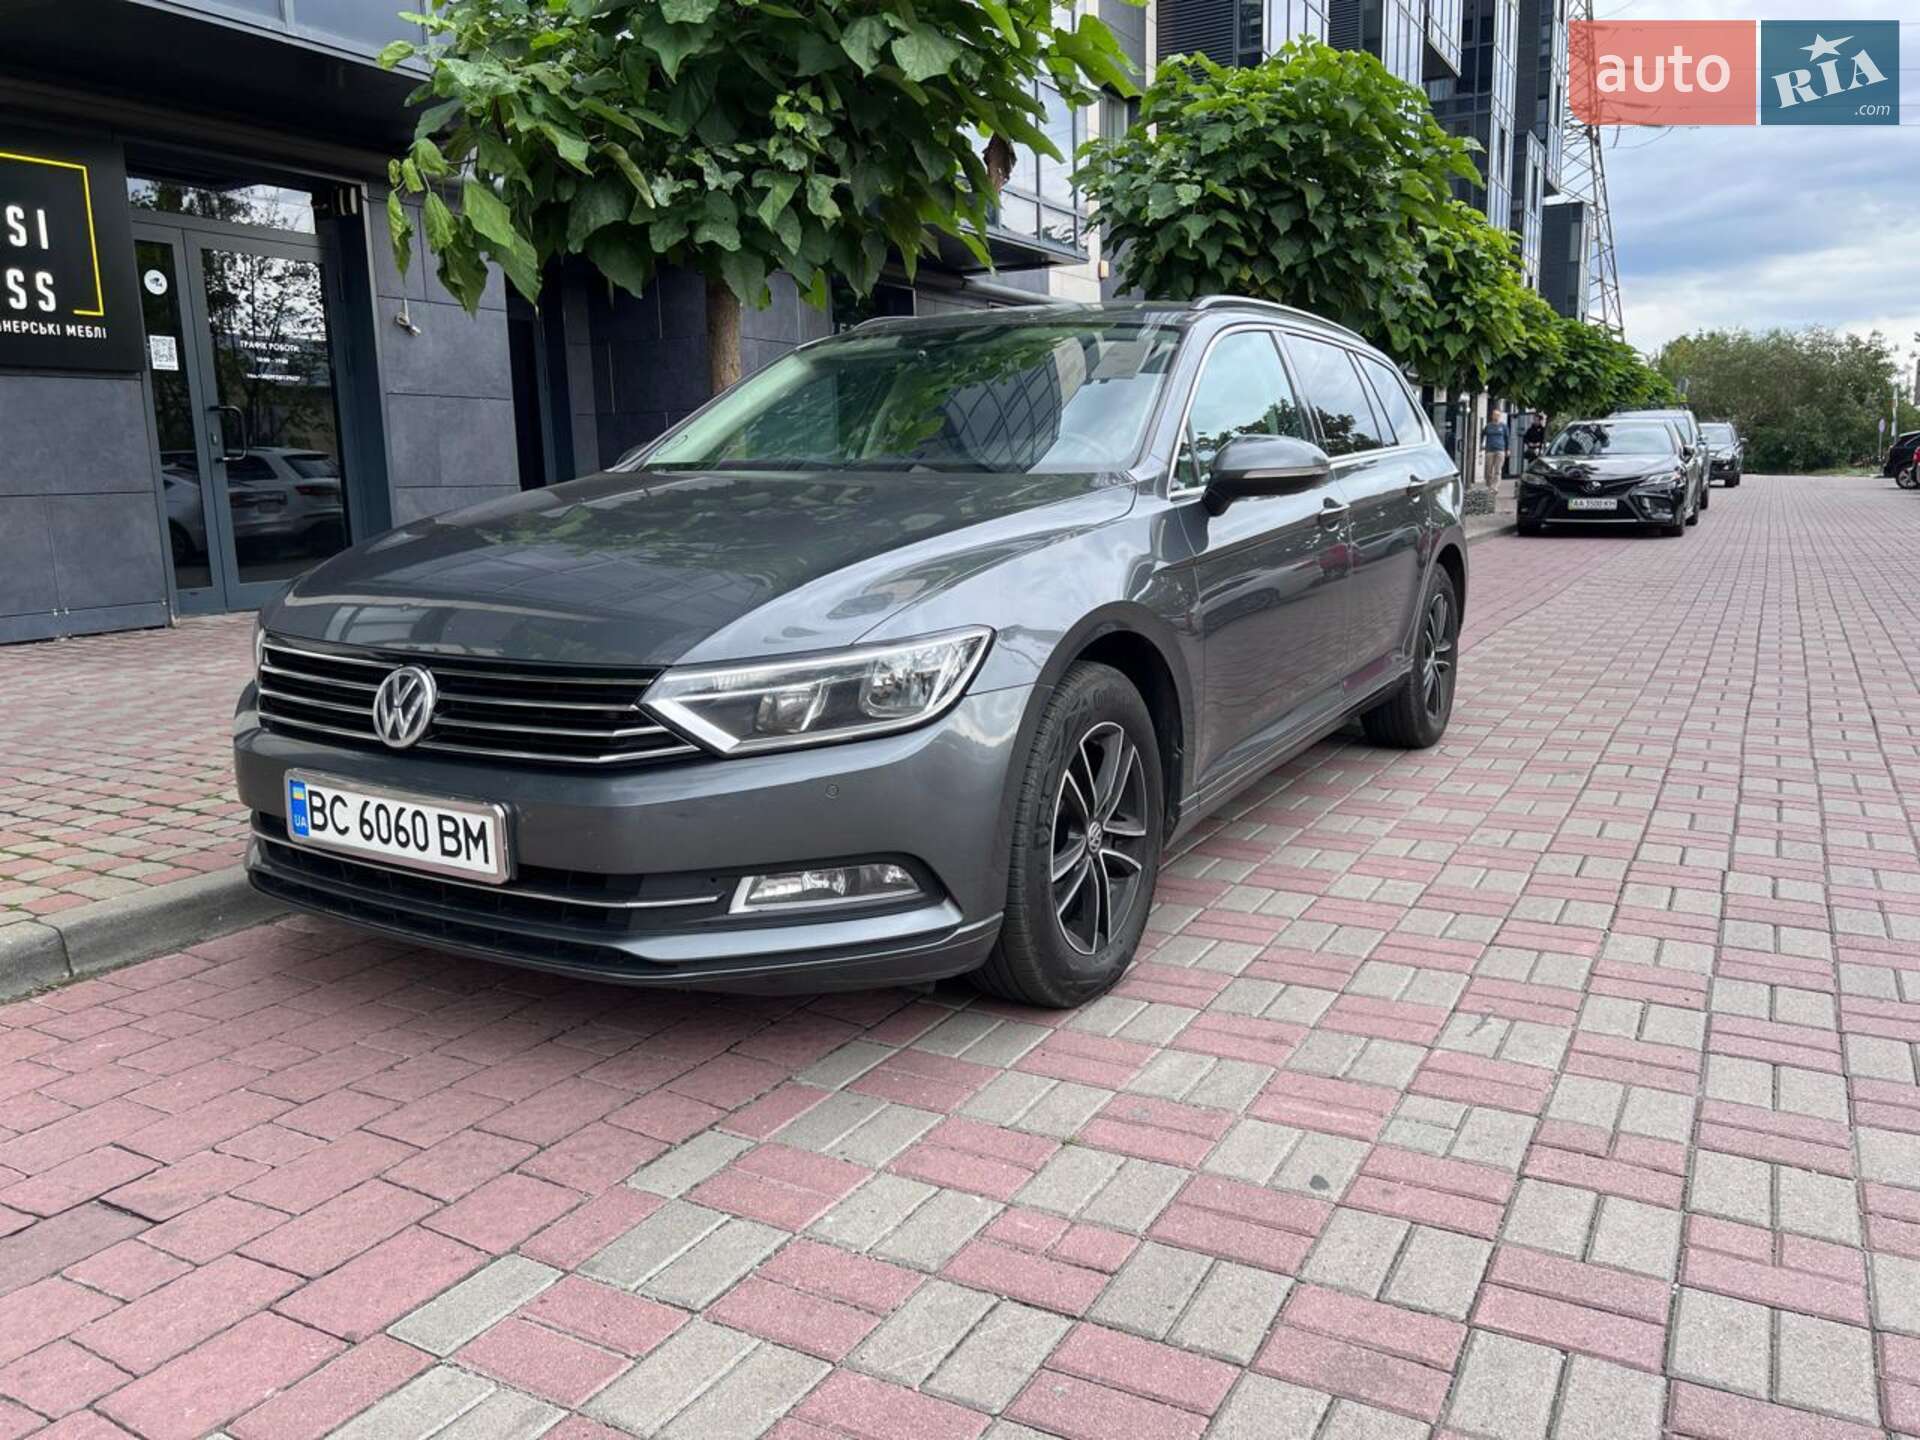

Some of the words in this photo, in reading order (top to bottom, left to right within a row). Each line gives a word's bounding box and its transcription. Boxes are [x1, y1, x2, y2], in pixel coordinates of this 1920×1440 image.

[0, 319, 61, 336] НЕРСЬКІ
[66, 324, 107, 339] МЕБЛІ
[294, 815, 307, 828] UA
[308, 789, 350, 836] BC
[359, 800, 429, 852] 6060
[437, 813, 490, 865] BM
